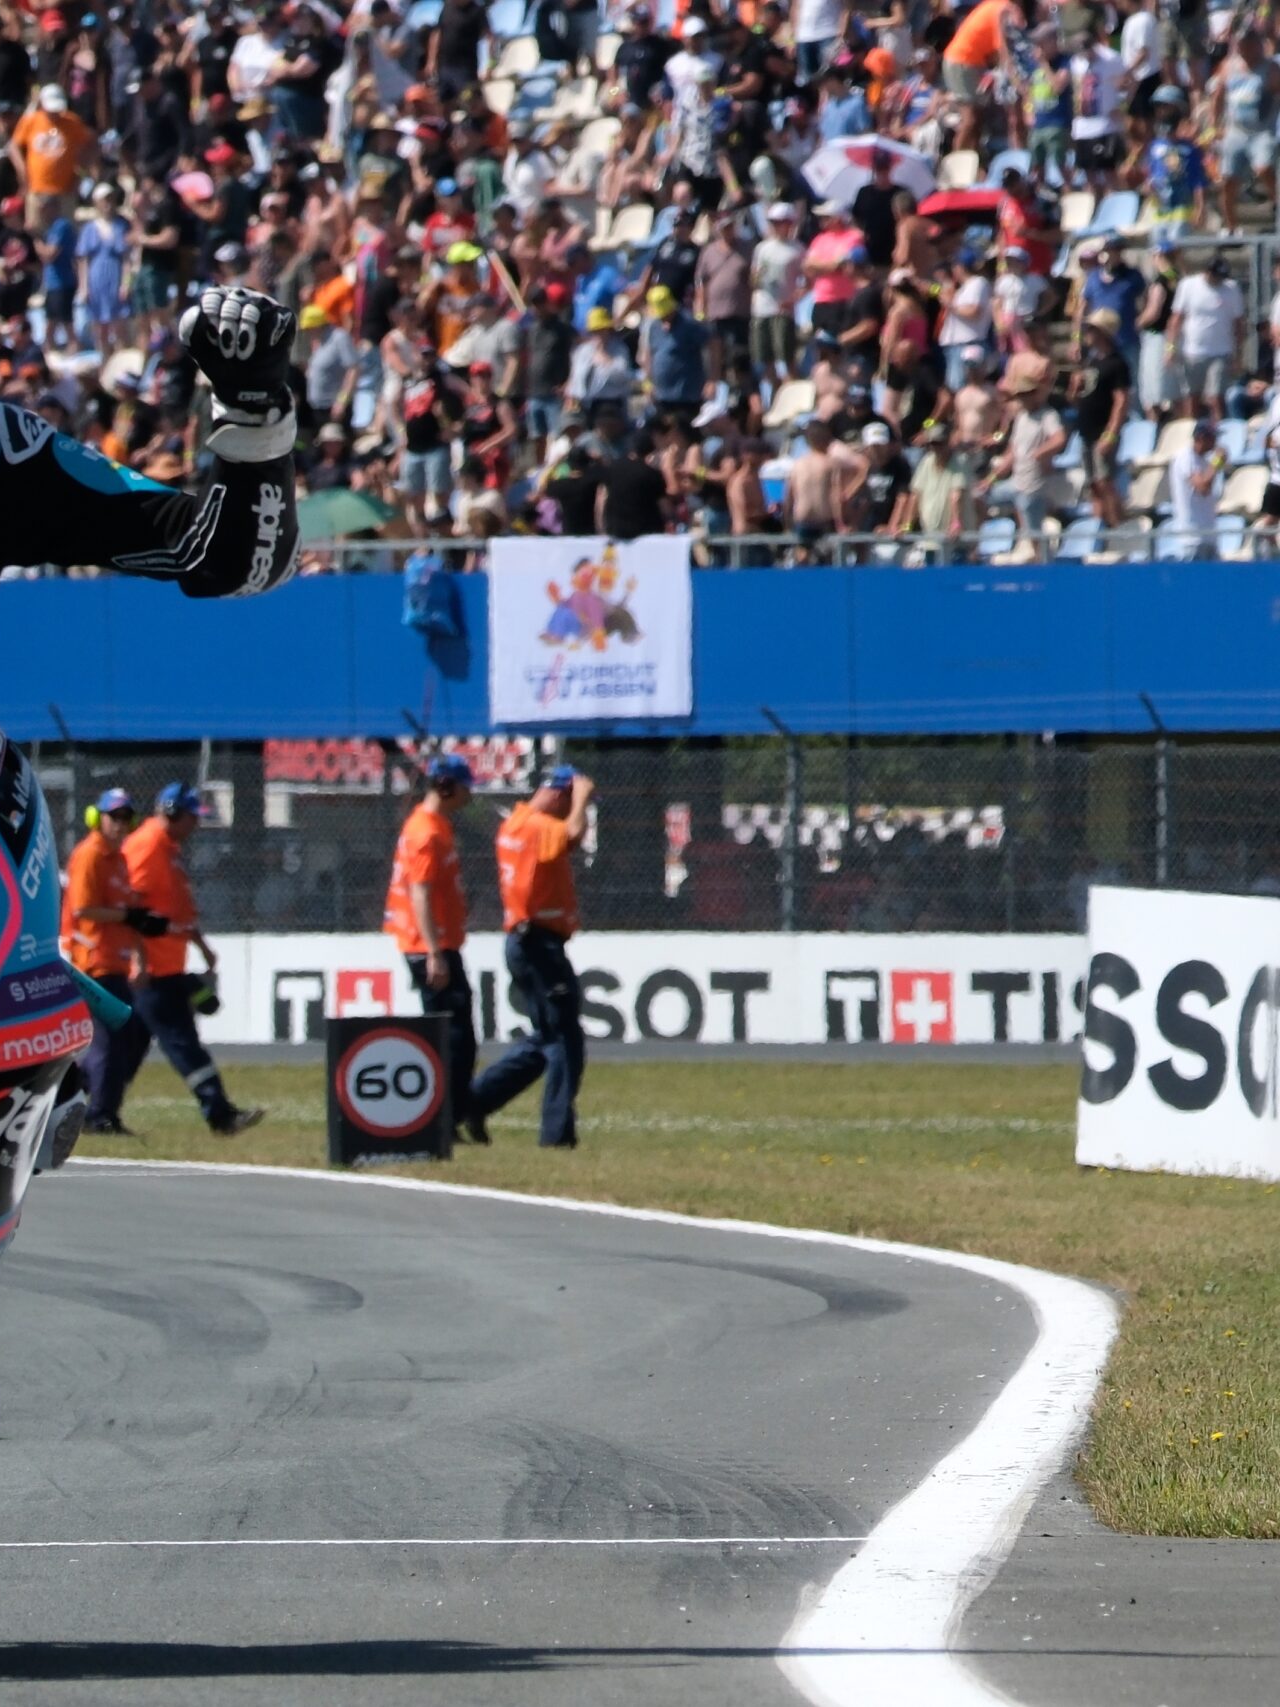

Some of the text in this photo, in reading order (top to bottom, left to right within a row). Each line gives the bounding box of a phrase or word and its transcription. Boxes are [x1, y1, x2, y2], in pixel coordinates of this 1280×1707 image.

[24, 972, 71, 994] solunion
[2, 1017, 94, 1061] mapfre
[356, 1064, 428, 1099] 60
